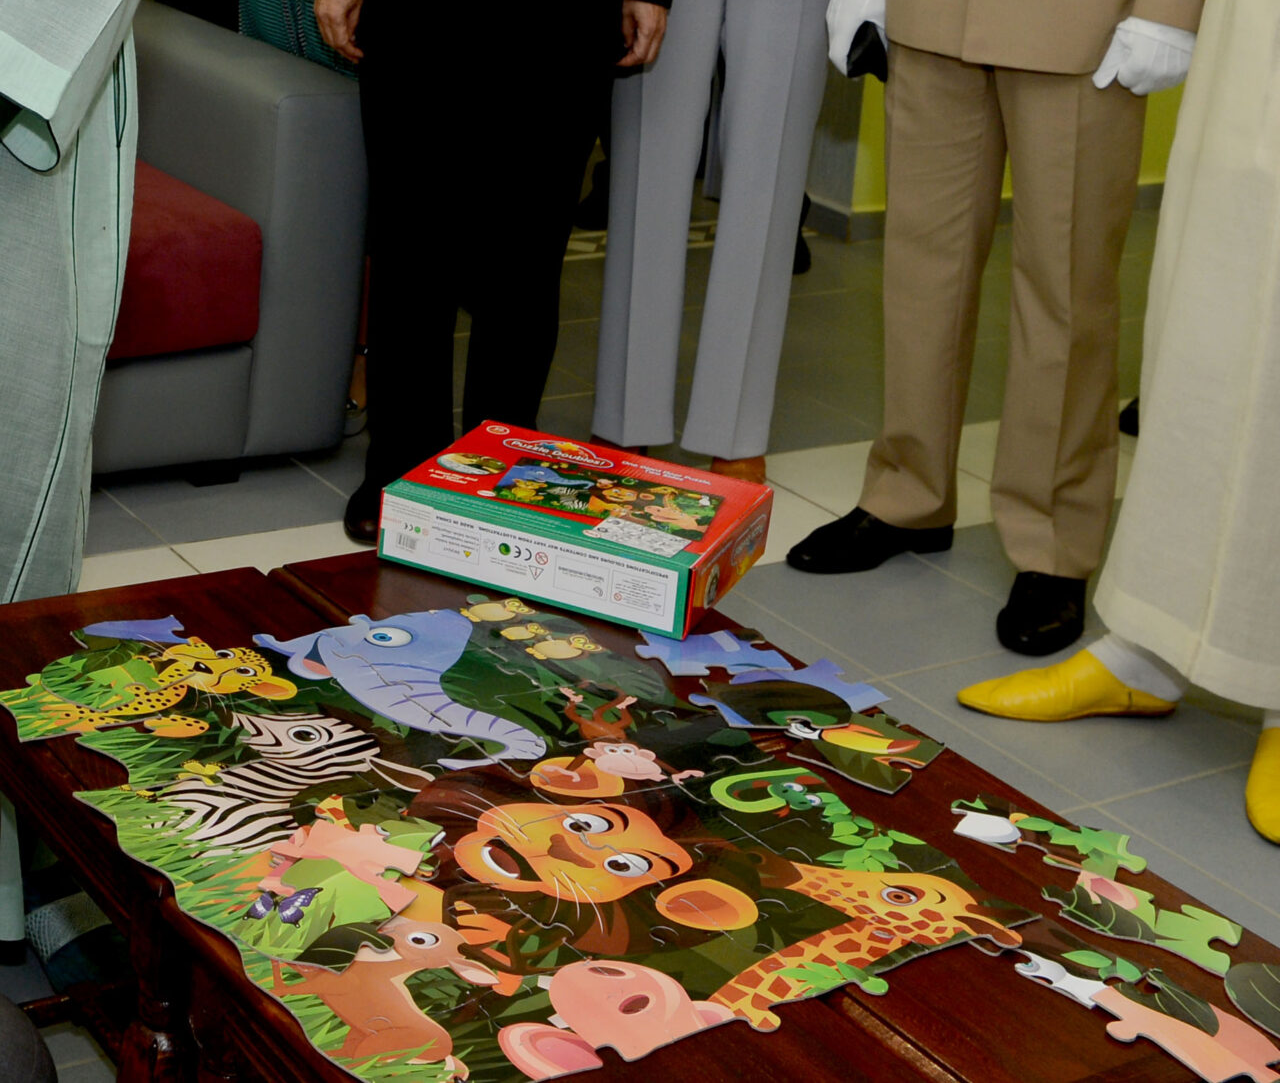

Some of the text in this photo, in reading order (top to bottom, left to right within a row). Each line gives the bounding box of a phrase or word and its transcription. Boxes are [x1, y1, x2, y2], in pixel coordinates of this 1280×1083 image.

[511, 440, 606, 466] Puzzle Doubles!
[436, 515, 451, 524] CHINA
[460, 521, 474, 529] MADE
[559, 545, 587, 558] CONTENTS
[600, 557, 625, 567] COLOURS
[626, 563, 669, 579] SPECIFICATIONS
